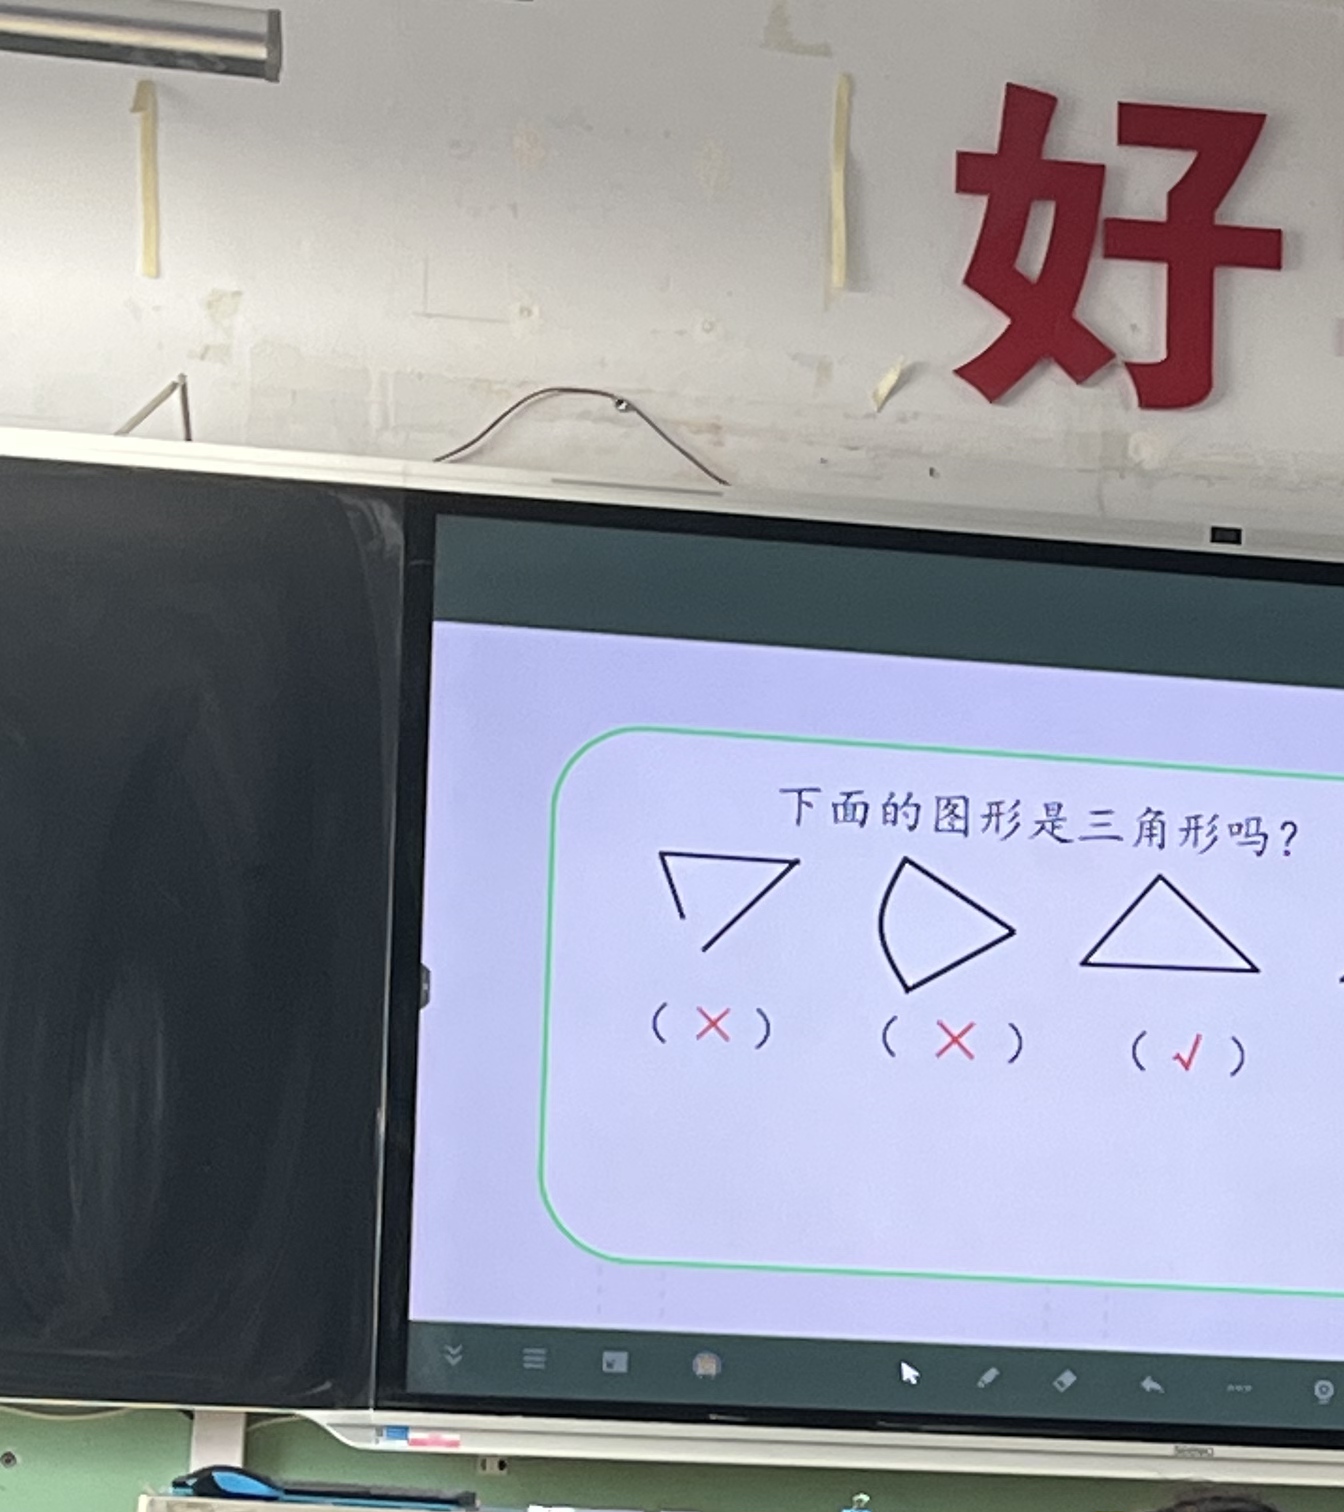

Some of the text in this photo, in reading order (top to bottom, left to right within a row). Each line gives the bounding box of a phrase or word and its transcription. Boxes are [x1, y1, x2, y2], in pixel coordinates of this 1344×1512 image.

[780, 788, 1298, 857] 下面的图形是三角形吗?
